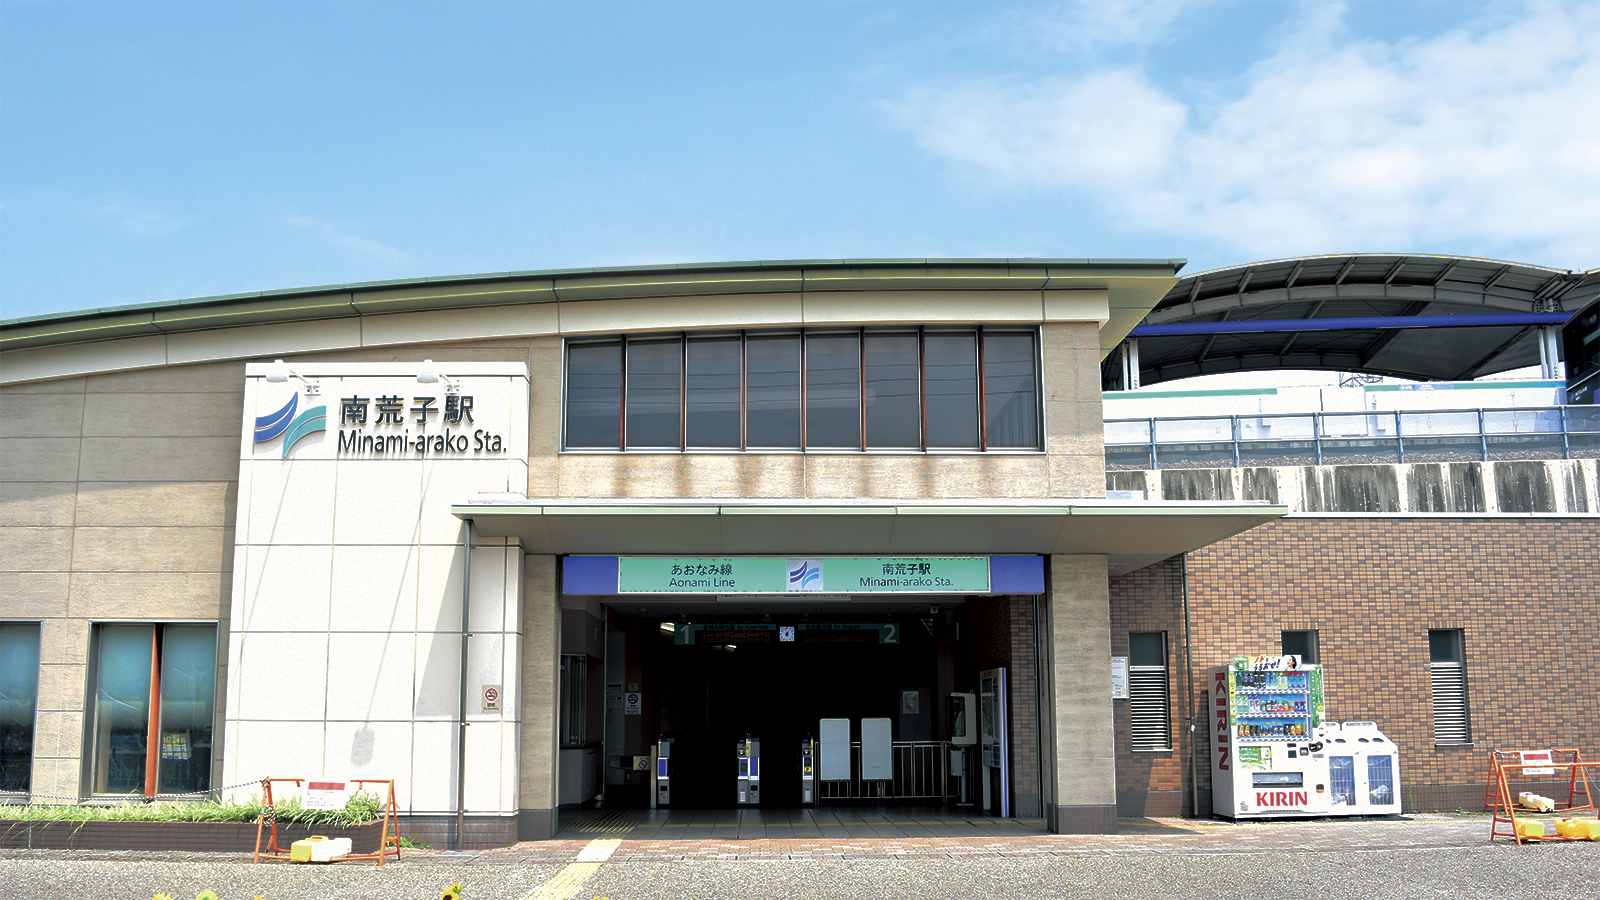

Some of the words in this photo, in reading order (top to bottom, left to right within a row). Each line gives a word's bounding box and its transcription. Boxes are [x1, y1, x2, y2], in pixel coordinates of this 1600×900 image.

[341, 394, 474, 424] 南荒子駅
[338, 427, 469, 453] Minami-arako
[473, 428, 507, 453] Sta.
[671, 563, 733, 576] あおなみ線
[882, 562, 931, 576] 南荒子駅
[669, 577, 711, 588] Aonami
[713, 577, 736, 588] Line
[859, 577, 933, 587] Minami-arako
[934, 577, 954, 587] Sta.
[680, 624, 690, 644] 1
[883, 624, 897, 643] 2
[1215, 672, 1230, 771] KIRIN
[1256, 791, 1308, 807] KIRIN
